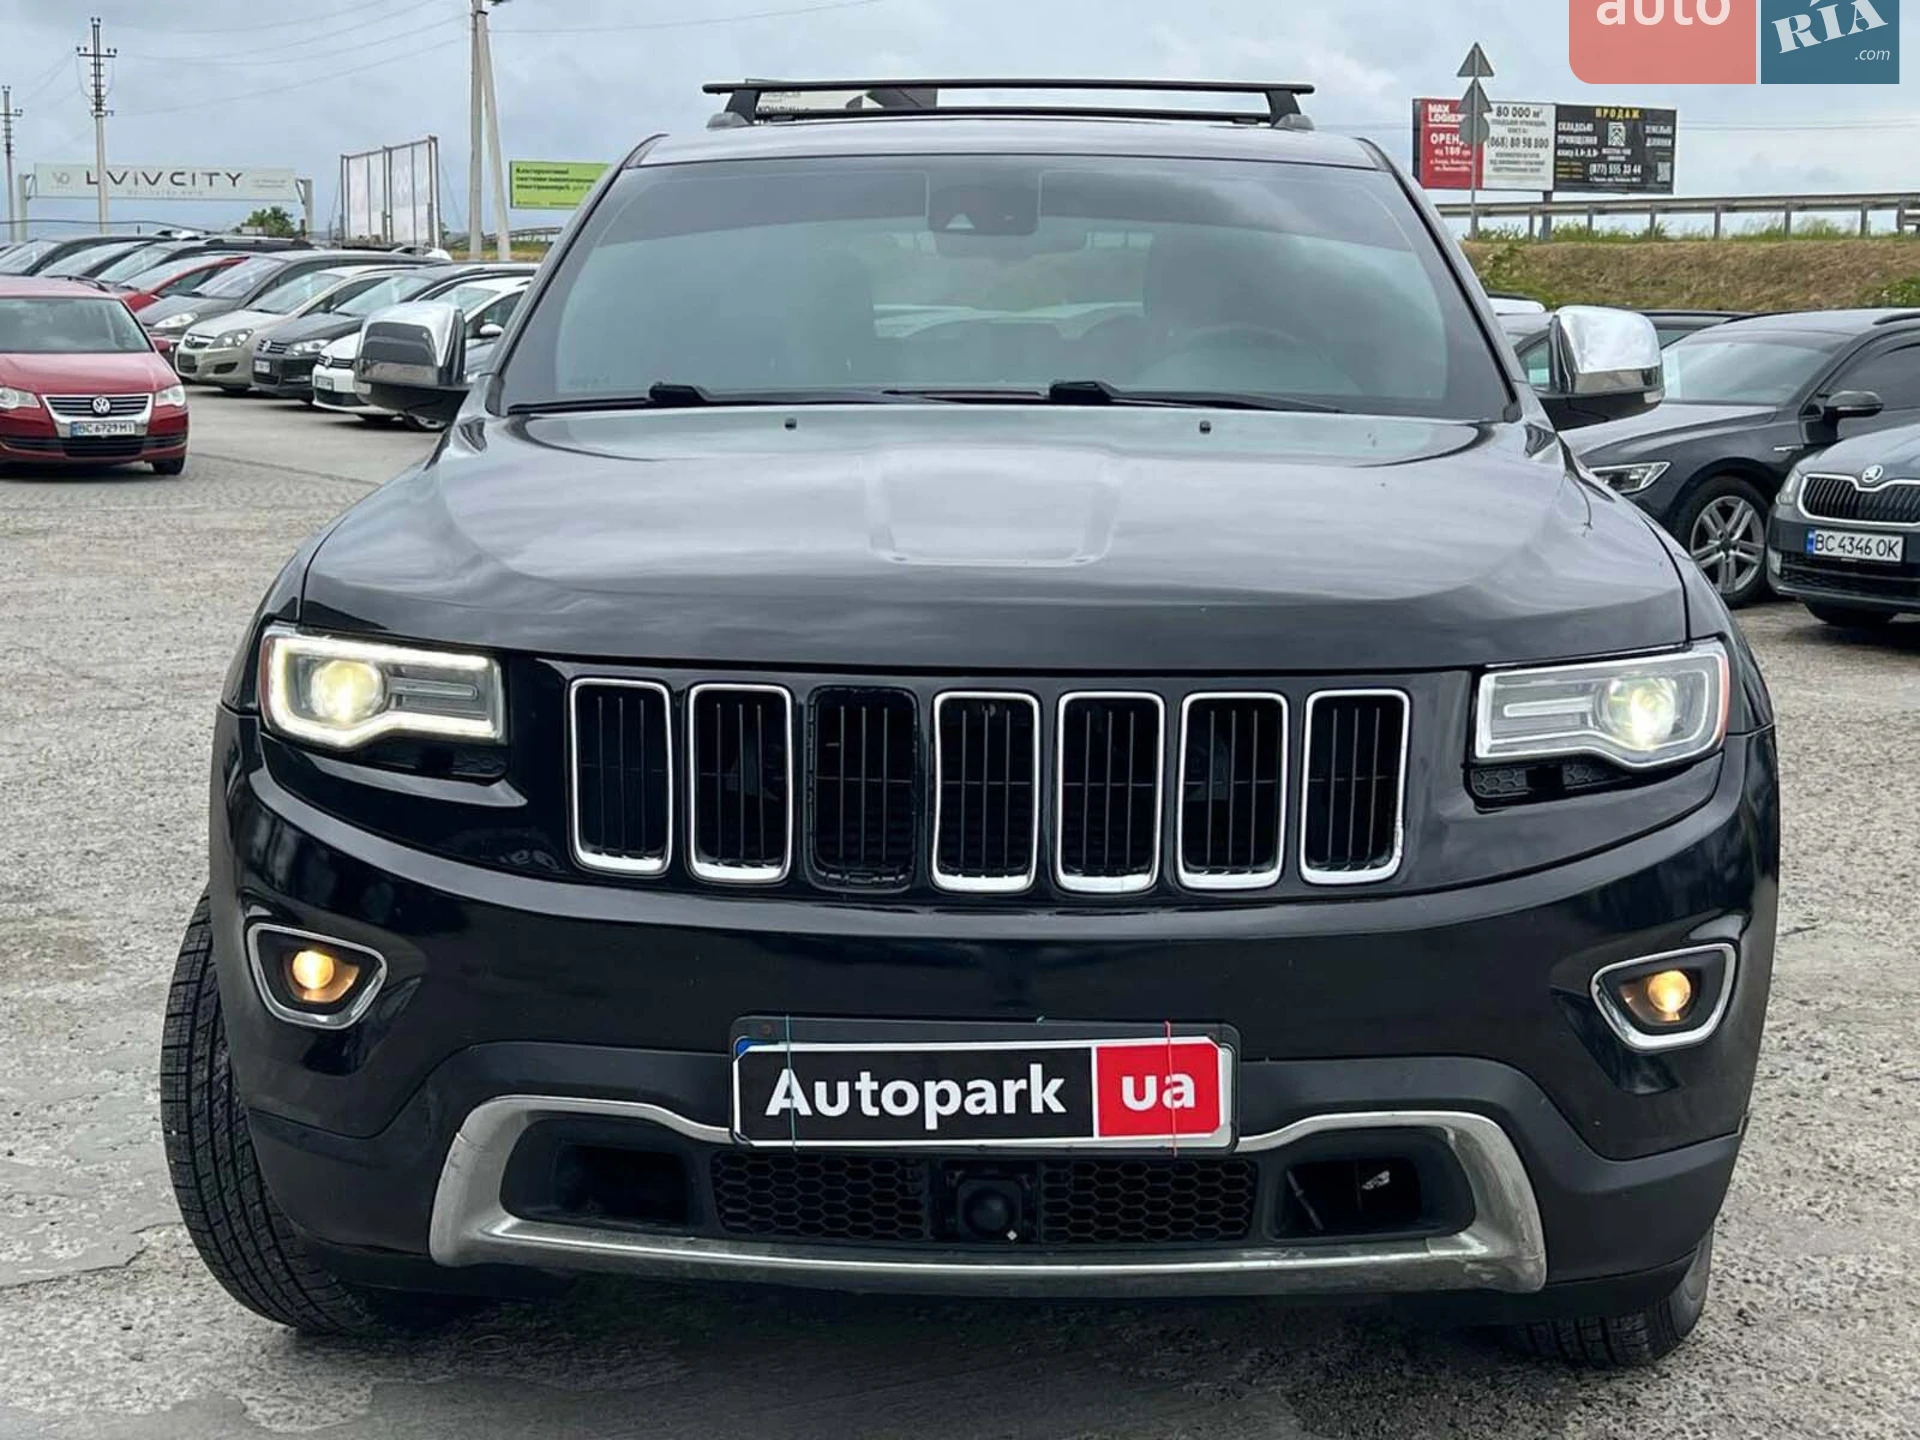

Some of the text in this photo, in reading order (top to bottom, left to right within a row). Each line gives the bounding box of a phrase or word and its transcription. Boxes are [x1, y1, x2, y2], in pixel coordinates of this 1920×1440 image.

[1496, 105, 1510, 118] 80
[1511, 106, 1531, 119] 000
[1595, 107, 1640, 119] ПРОДАЖ
[86, 170, 243, 188] LVIVCITY
[1815, 533, 1836, 552] BC
[1838, 536, 1873, 556] 4346
[1876, 539, 1900, 559] OK
[765, 1063, 1196, 1130] Autopark ua
